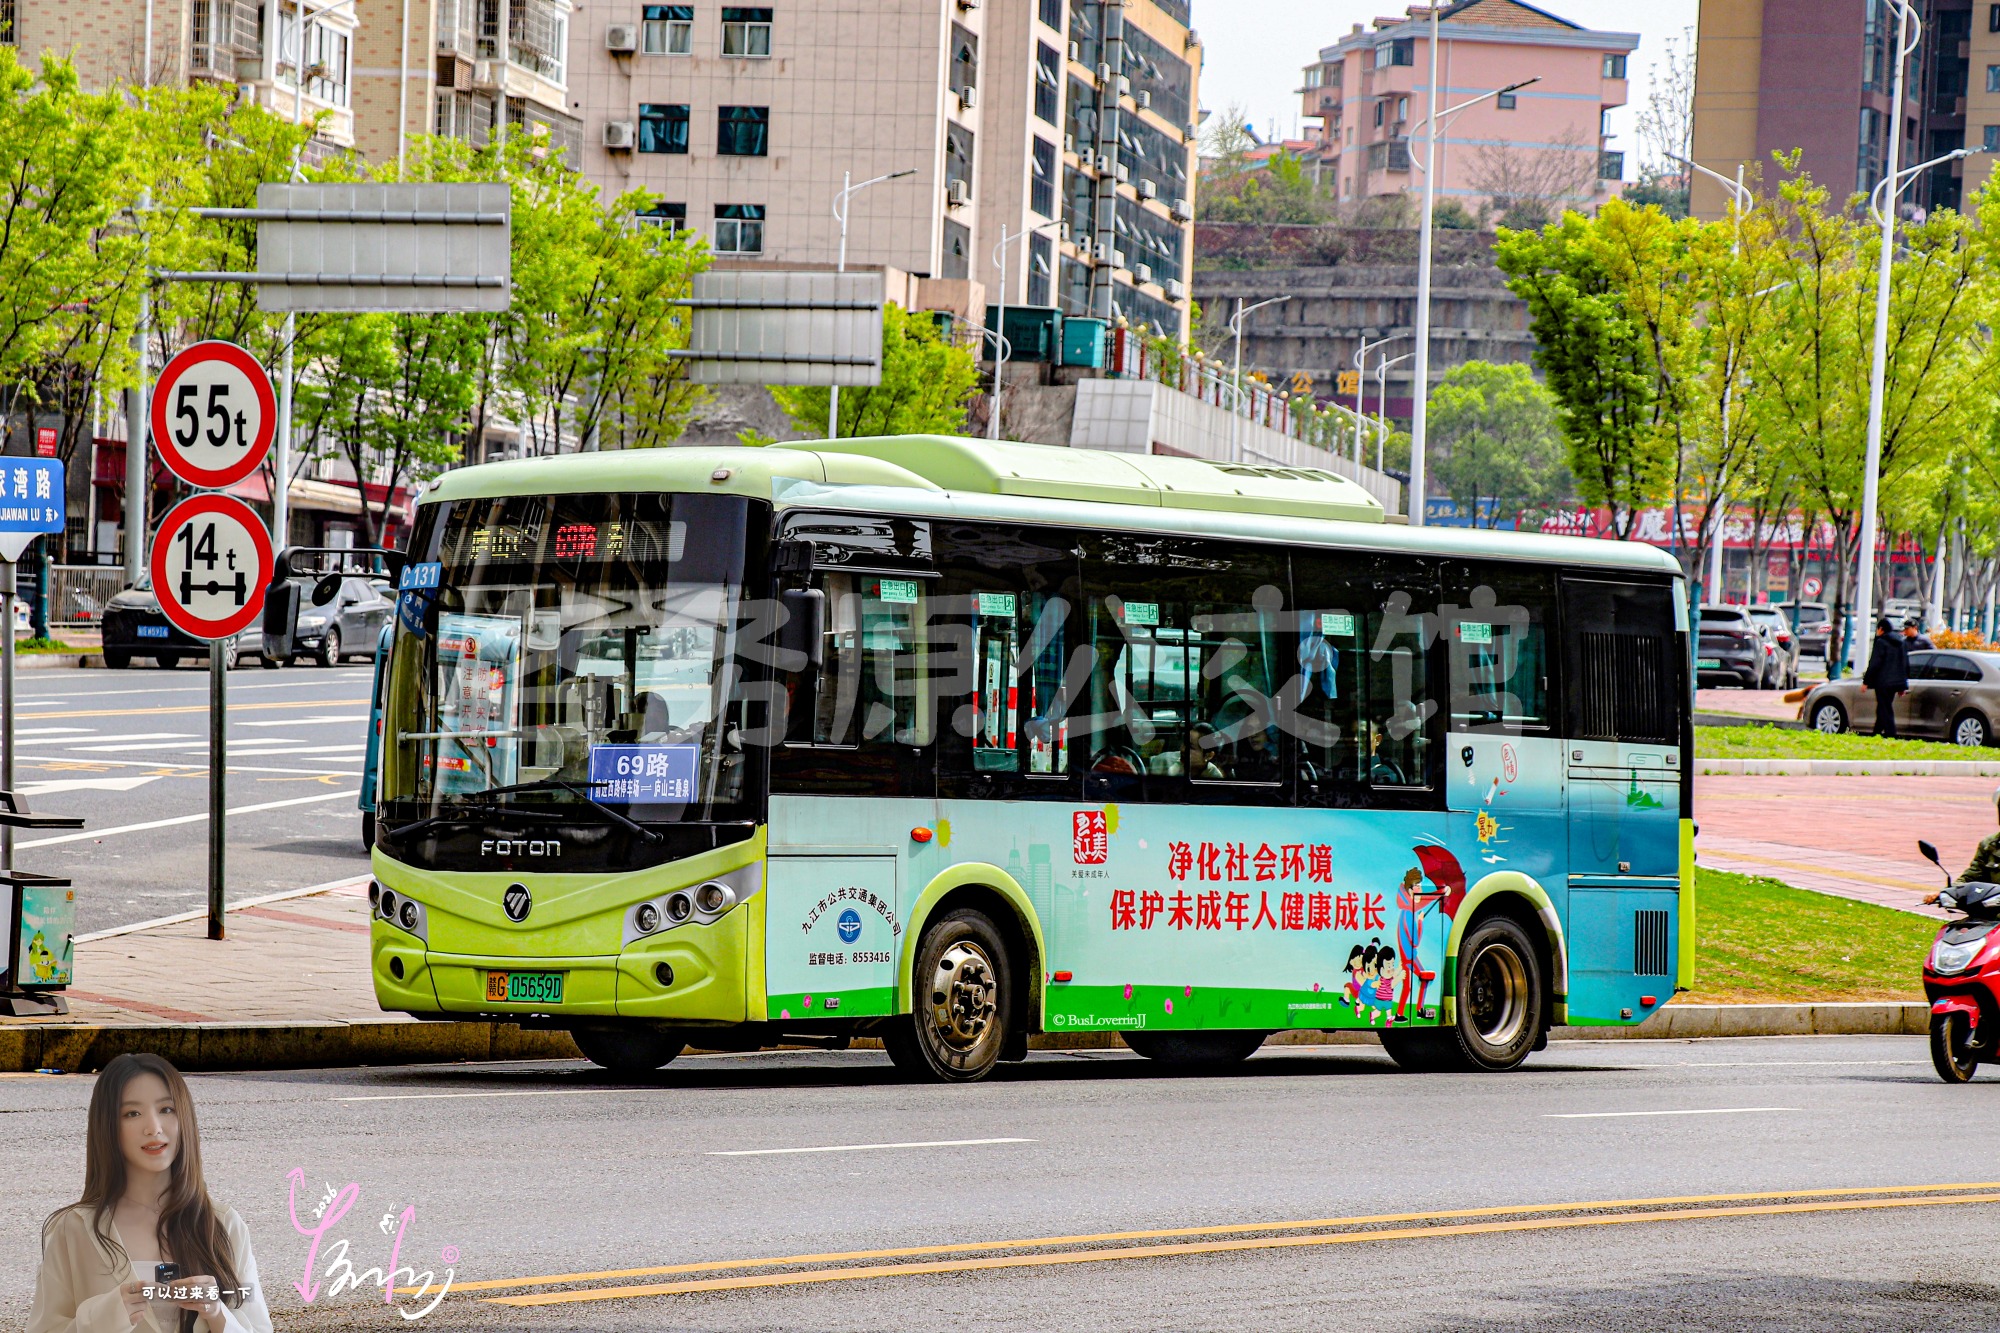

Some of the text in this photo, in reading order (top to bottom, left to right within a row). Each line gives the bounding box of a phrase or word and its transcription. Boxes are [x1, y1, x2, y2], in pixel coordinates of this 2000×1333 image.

[30, 507, 40, 521] LU
[480, 839, 561, 857] FOTON
[1167, 840, 1333, 884] 净化社会环境
[801, 886, 903, 937] 九江市公共交通集团公司
[1109, 889, 1387, 932] 保护未成年人健康成长
